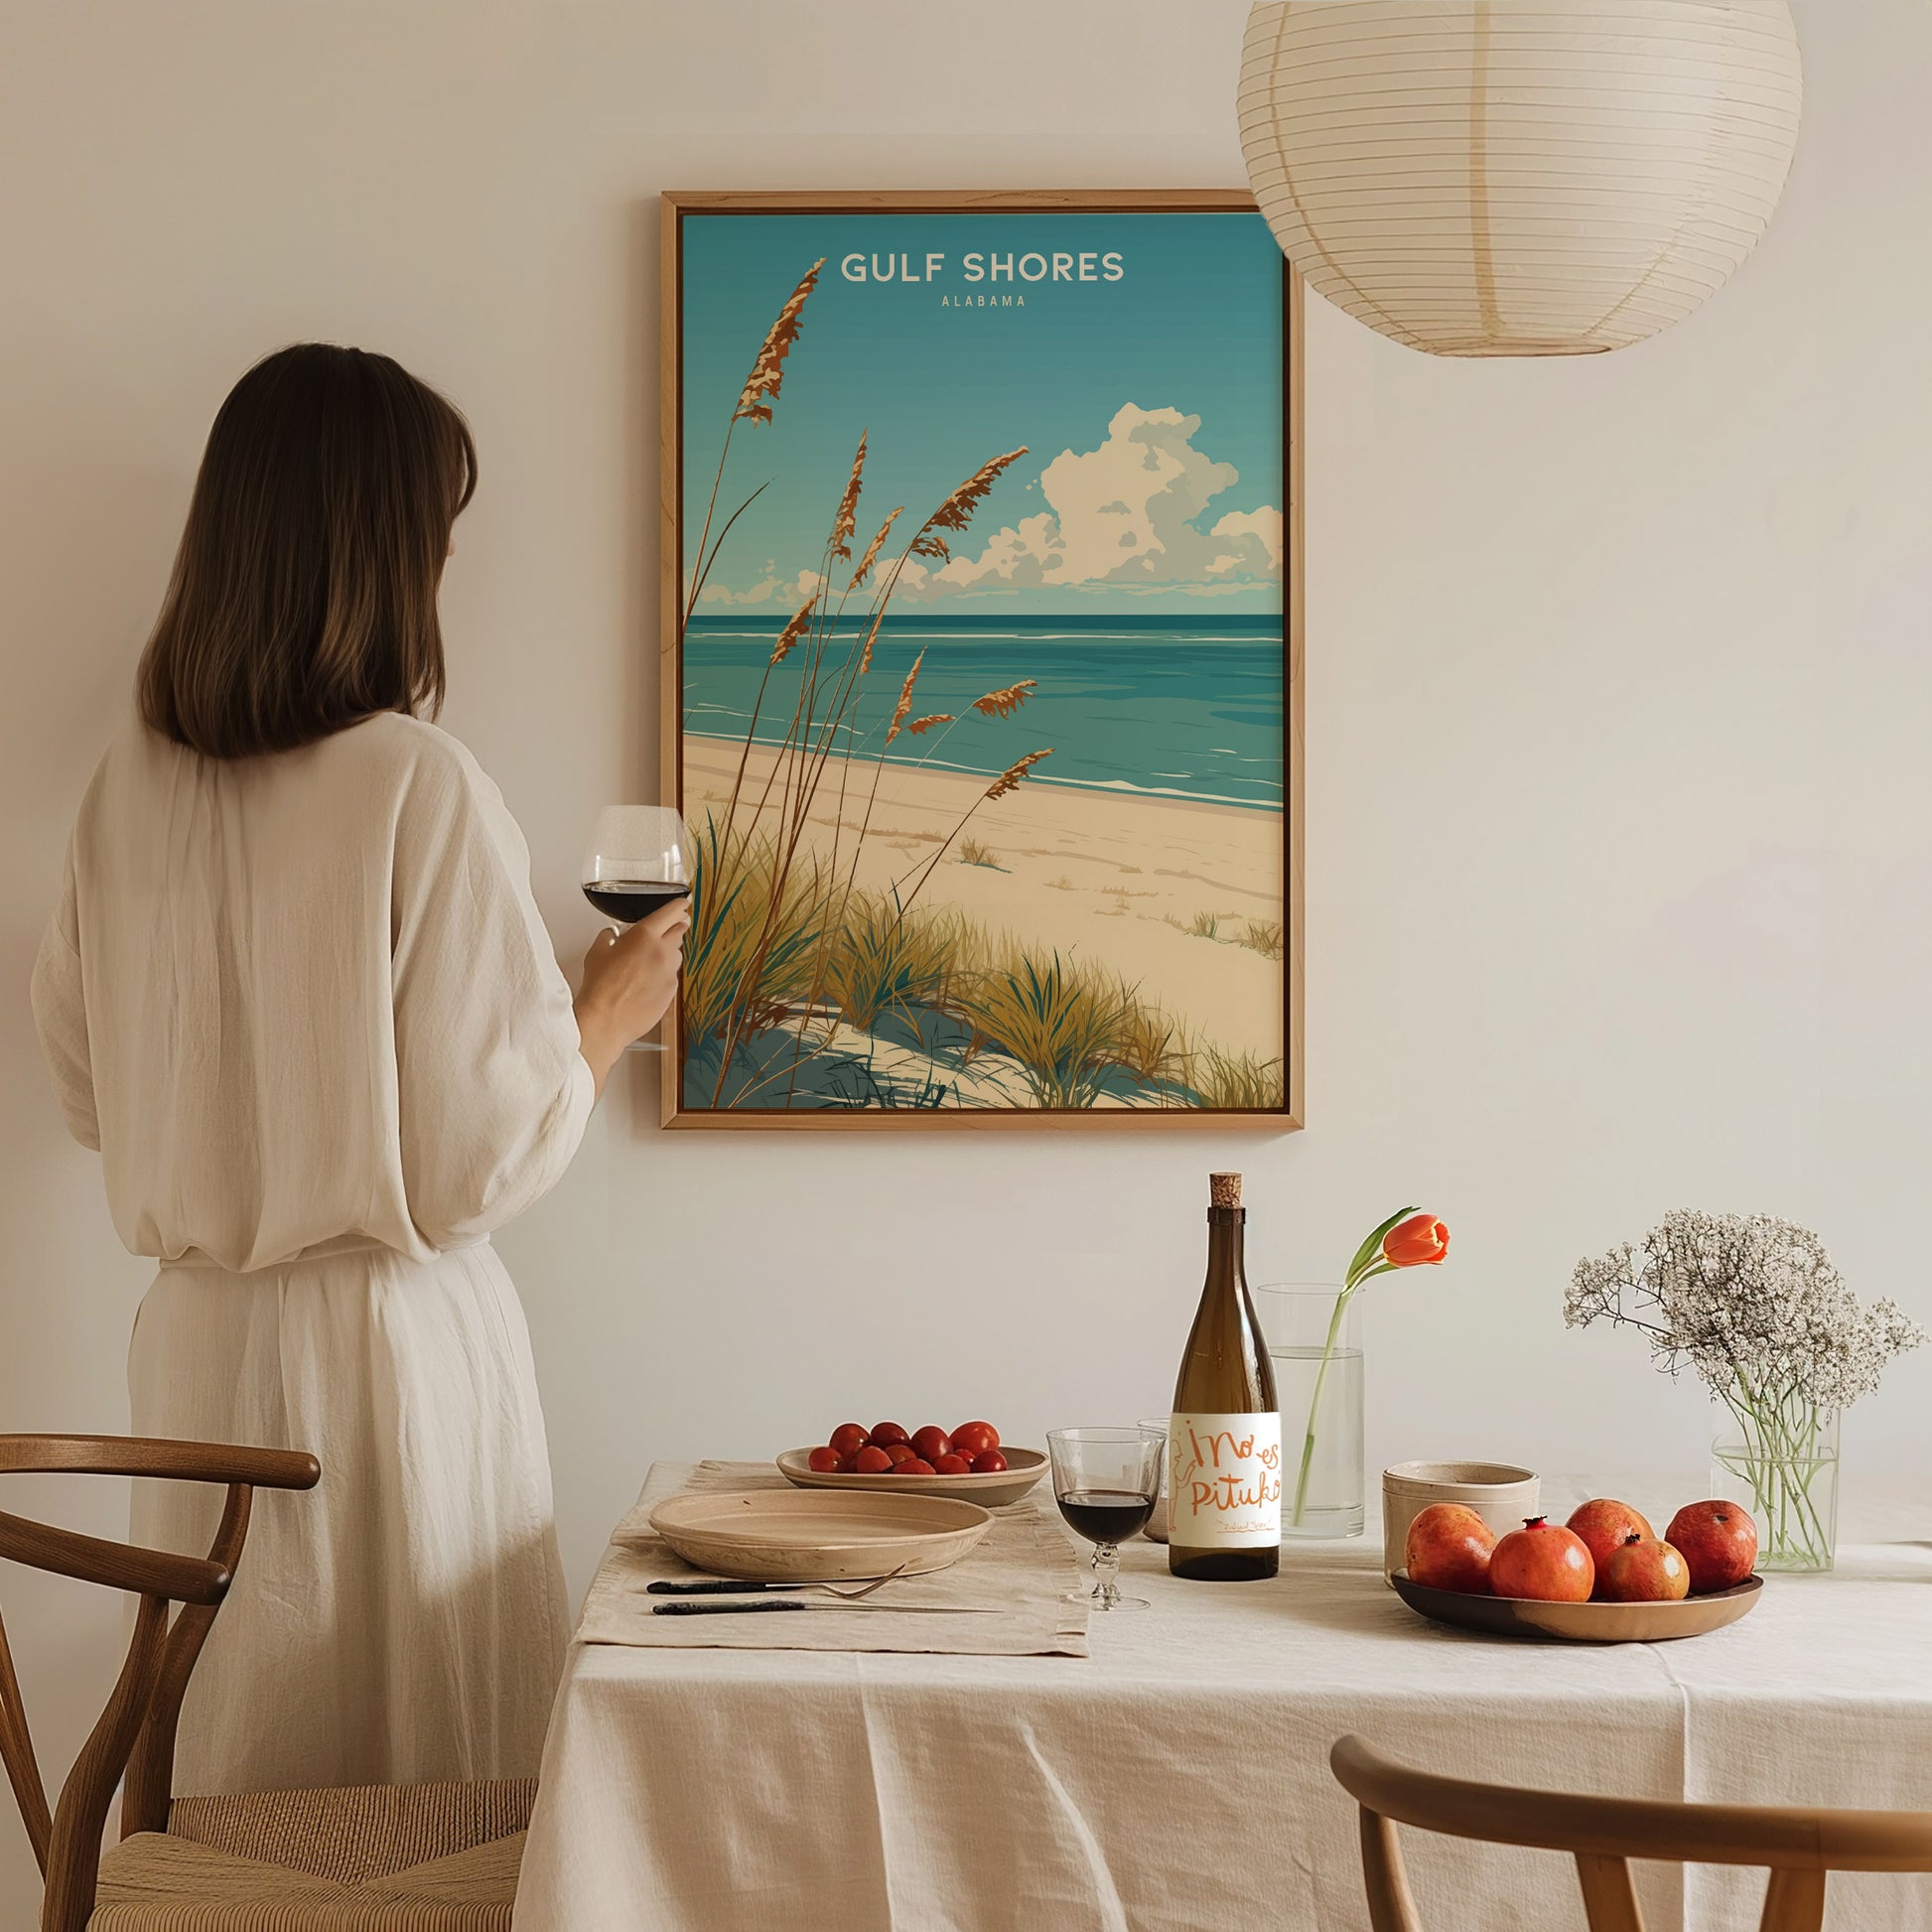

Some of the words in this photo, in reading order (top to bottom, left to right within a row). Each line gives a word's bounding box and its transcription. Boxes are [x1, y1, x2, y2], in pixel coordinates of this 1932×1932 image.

[841, 252, 945, 283] GULF
[962, 252, 1125, 283] SHORES
[941, 295, 1026, 308] ALABAMA
